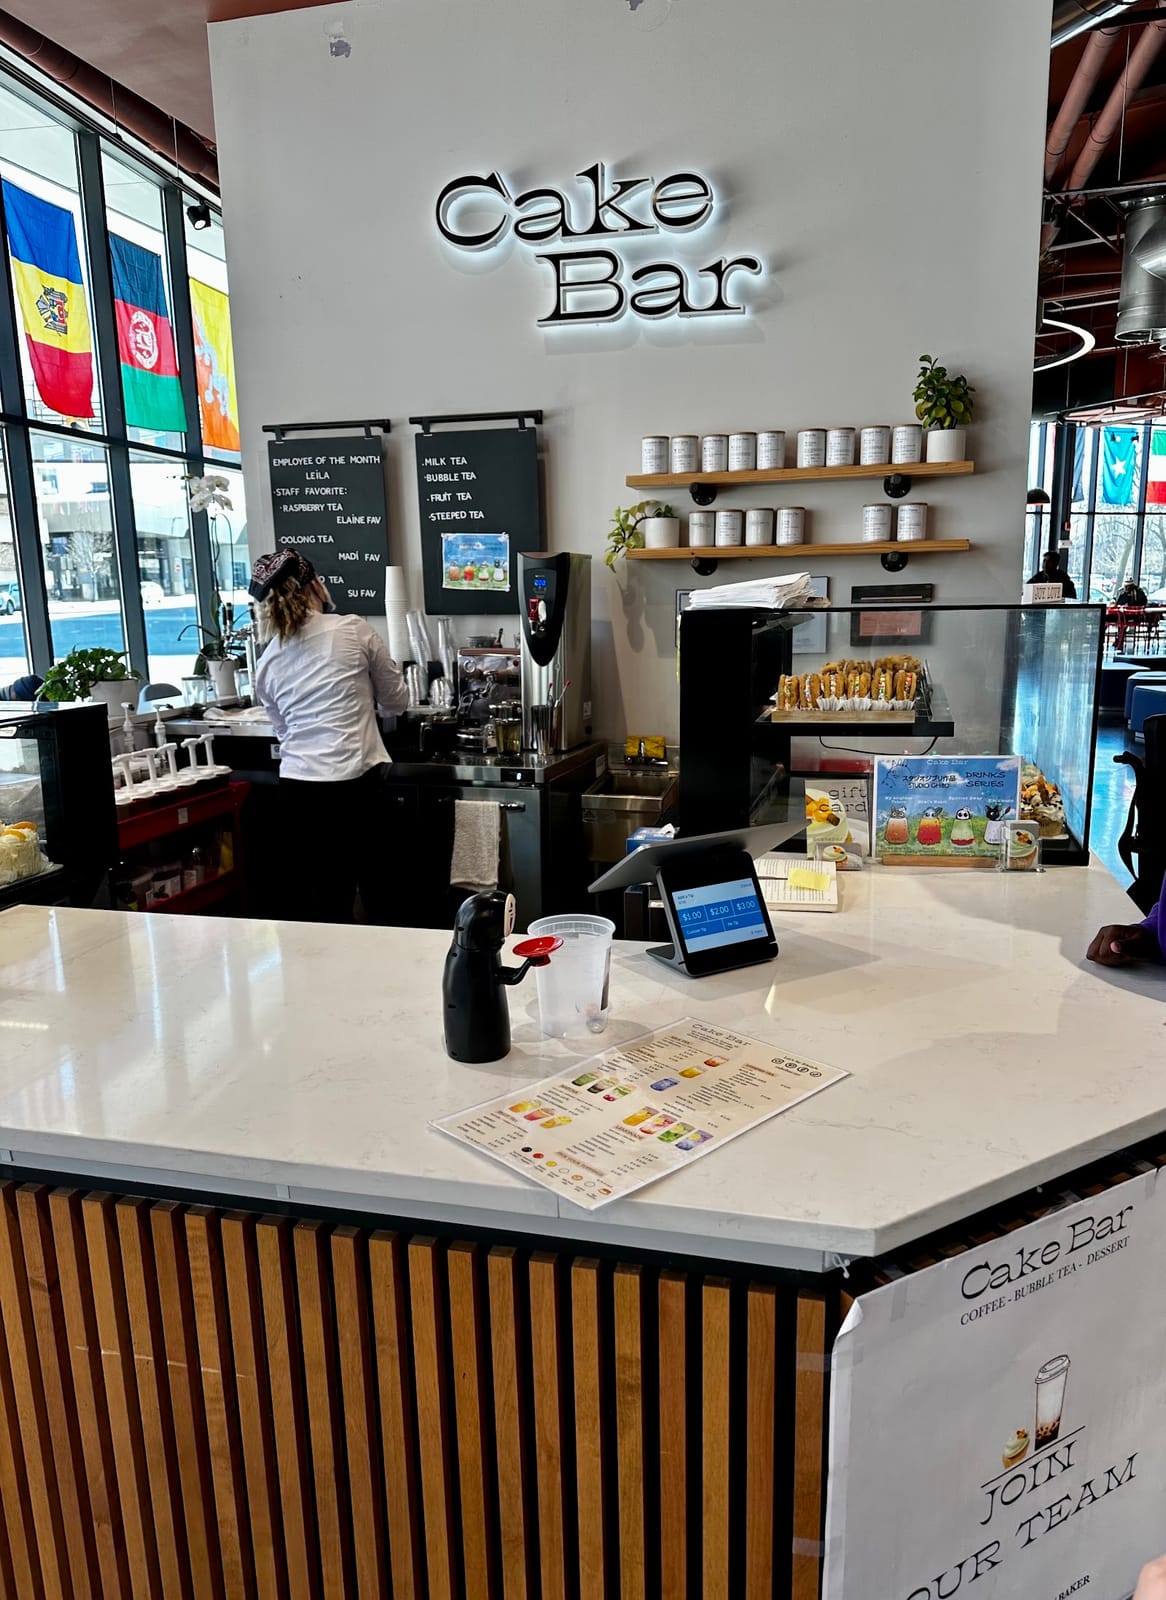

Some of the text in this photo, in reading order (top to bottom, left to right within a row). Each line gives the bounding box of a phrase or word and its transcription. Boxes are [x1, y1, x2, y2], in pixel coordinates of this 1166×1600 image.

[436, 162, 713, 247] Cake
[535, 249, 761, 324] Bar
[272, 455, 381, 467] EMPLOYEE OF THE MONTH
[424, 456, 468, 466] MILK TEA
[426, 471, 477, 482] BUBBLE TEA
[275, 487, 348, 496] STAFF FAVORITE:
[456, 492, 473, 501] TEA
[282, 503, 344, 512] RASPBERRY TEA
[366, 516, 382, 525] FAV
[430, 510, 485, 522] STEEPED TEA
[280, 535, 335, 544] OOLONG TEA
[364, 554, 381, 562] FAV
[328, 576, 345, 584] TEA
[347, 589, 377, 598] SU FAV
[966, 771, 1006, 779] DRINKS
[965, 780, 1005, 788] SERIES
[828, 786, 867, 800] gift
[818, 801, 867, 812] card
[710, 905, 730, 917] $2.00
[736, 900, 756, 911] $3.00
[682, 910, 702, 922] $1.00
[961, 1205, 1134, 1299] Cake Bar
[960, 1235, 1131, 1326] COFFEE BUBBLE TEA DESSERT
[980, 1440, 1077, 1526] JOIN
[1015, 1452, 1139, 1549] TEAM
